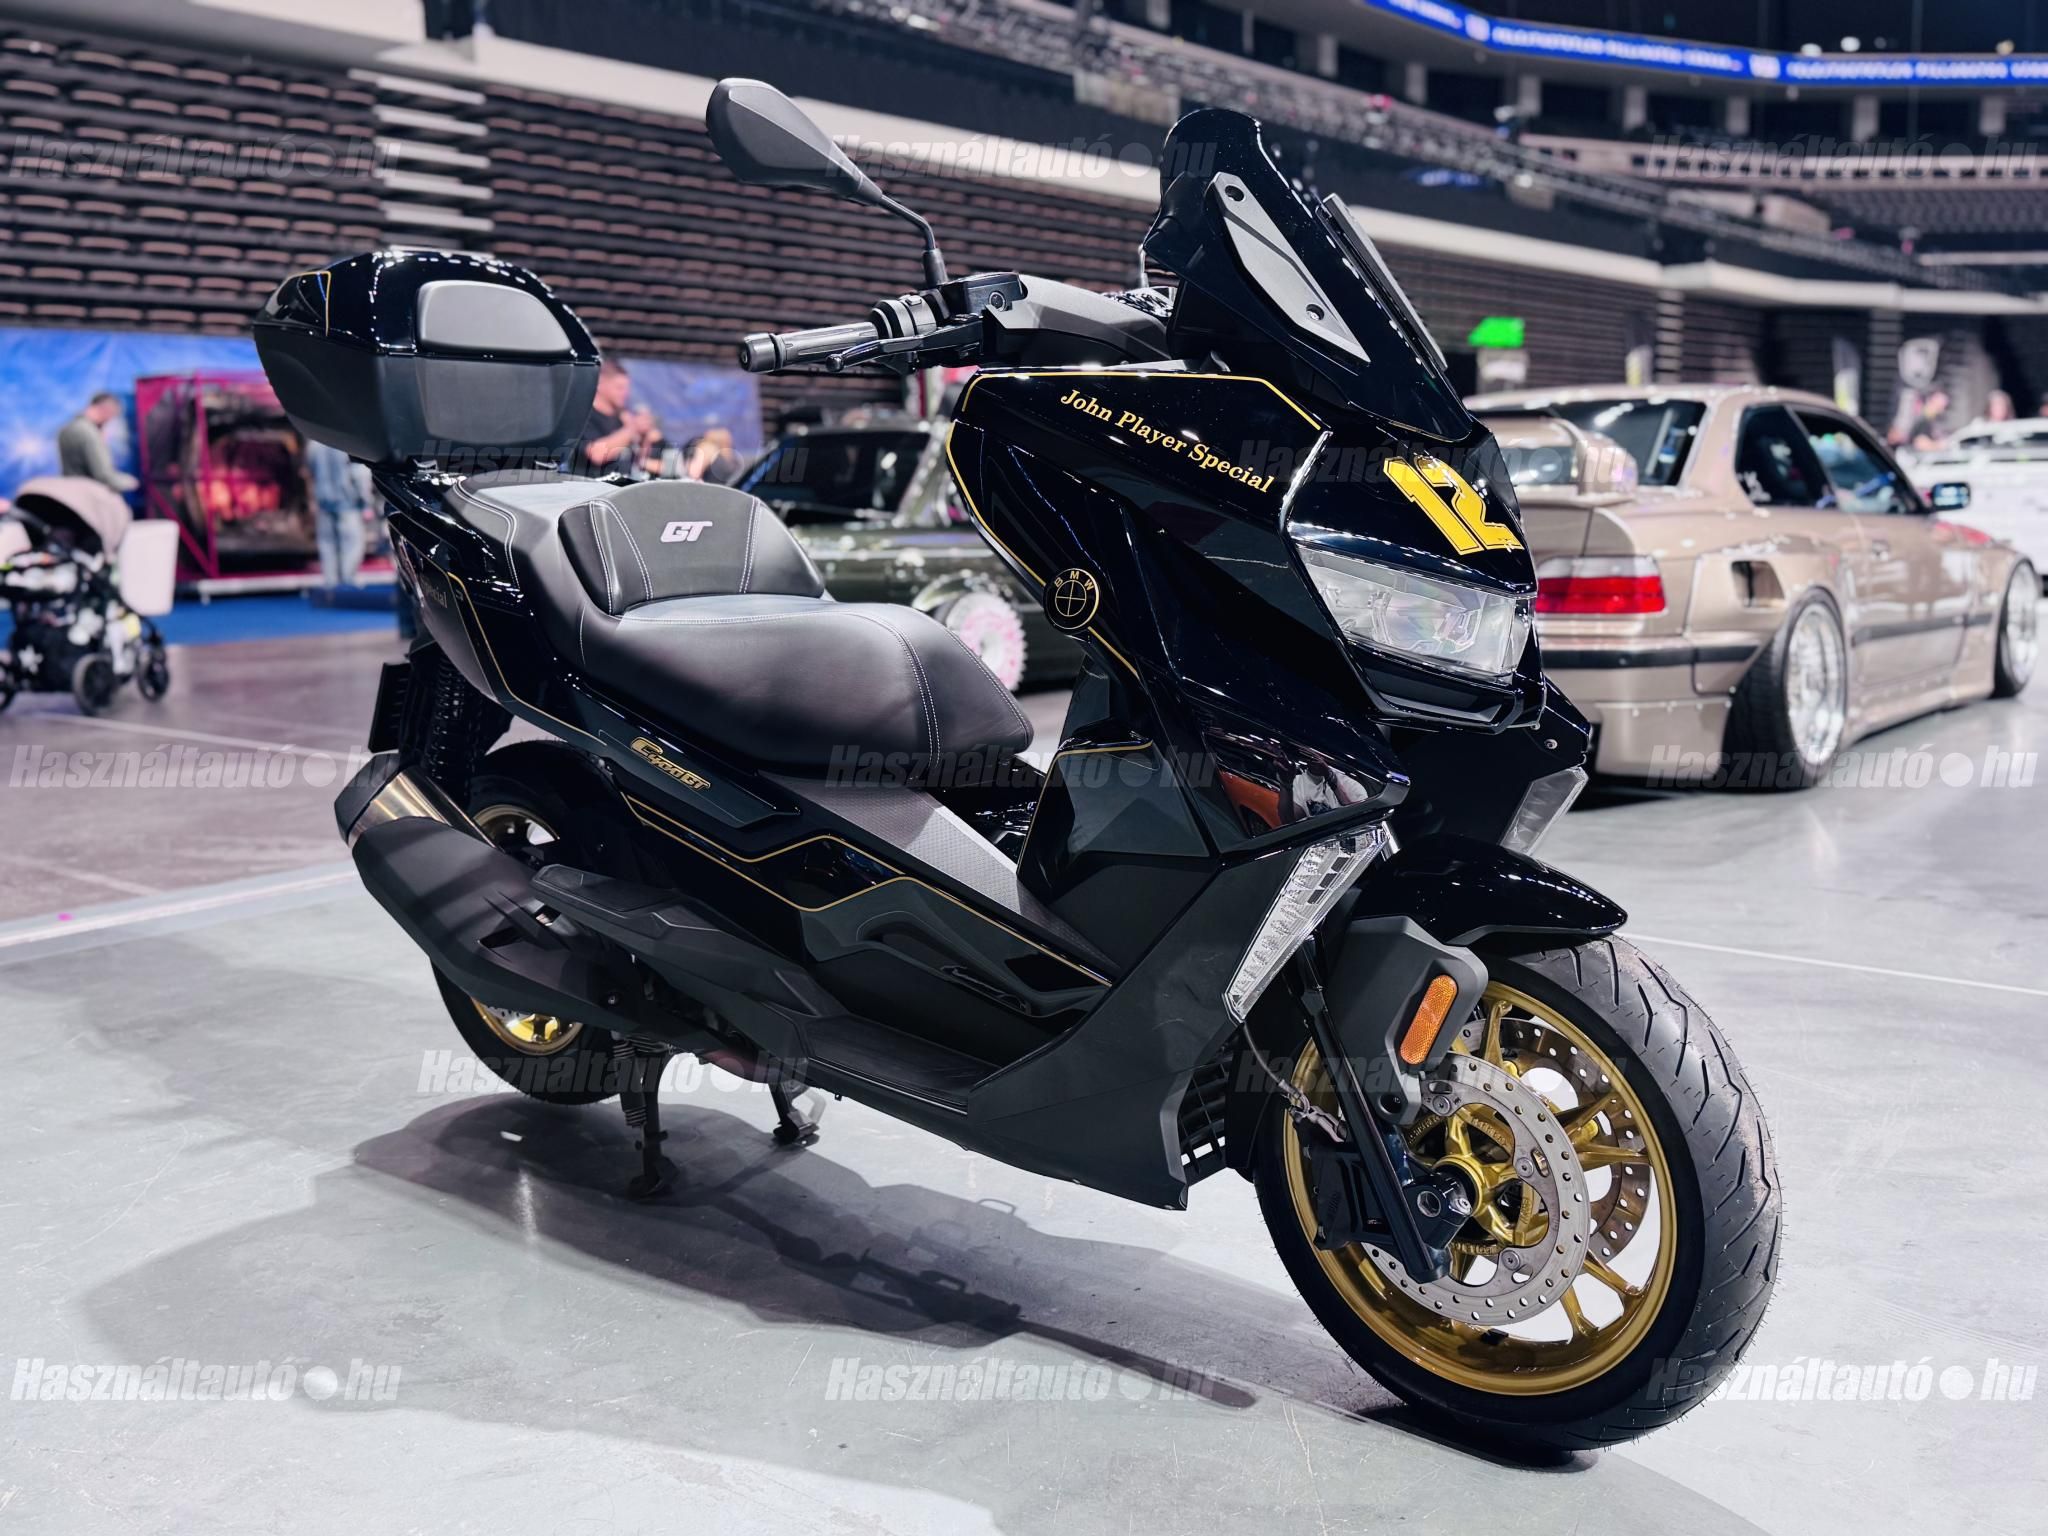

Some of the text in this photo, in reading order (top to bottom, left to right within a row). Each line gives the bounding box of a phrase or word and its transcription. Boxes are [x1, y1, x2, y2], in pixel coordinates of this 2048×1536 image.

[1060, 389, 1275, 493] John Player Special
[660, 520, 713, 543] GT
[1383, 455, 1525, 556] 12
[1053, 570, 1096, 592] BMW
